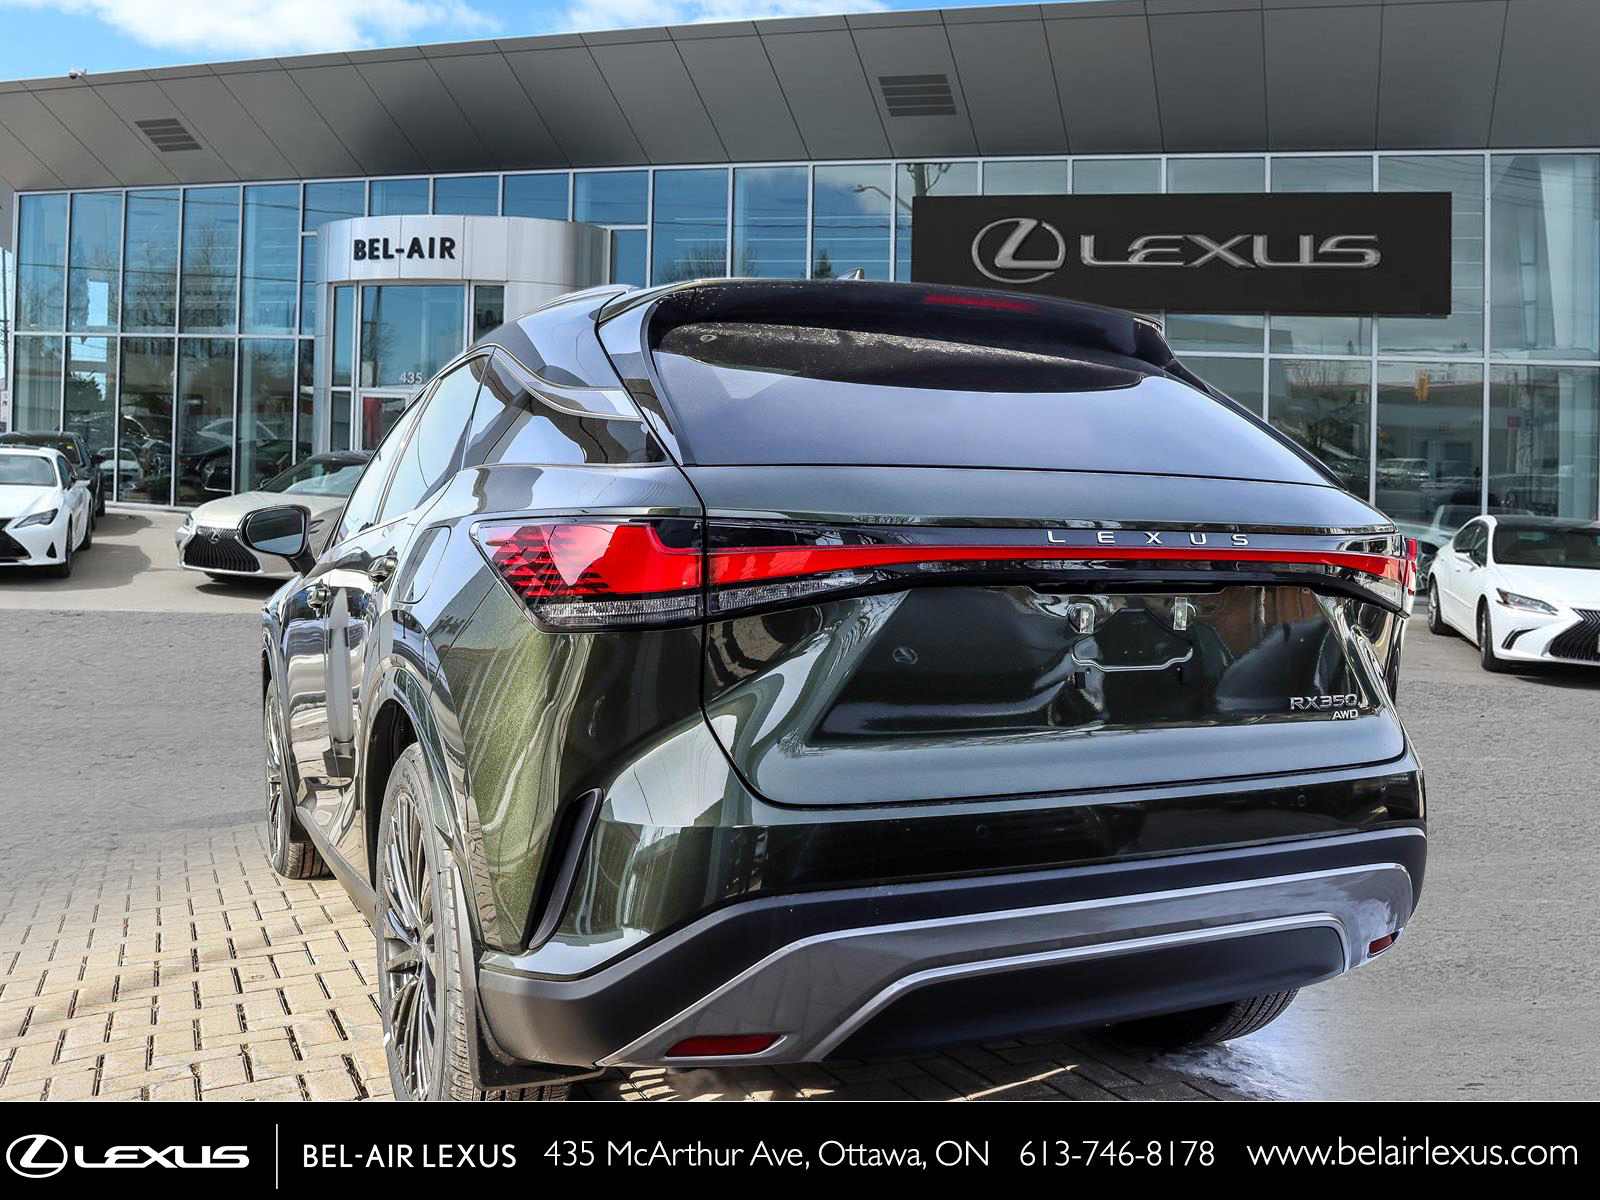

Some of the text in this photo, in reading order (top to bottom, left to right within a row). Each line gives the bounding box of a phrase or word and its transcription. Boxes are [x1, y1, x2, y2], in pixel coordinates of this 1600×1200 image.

[353, 236, 456, 261] BEL-AIR
[1080, 234, 1382, 268] LEXUS
[400, 371, 423, 384] 435
[1047, 530, 1249, 546] LEXUS
[1289, 693, 1358, 710] RX350
[1331, 709, 1359, 720] AWD
